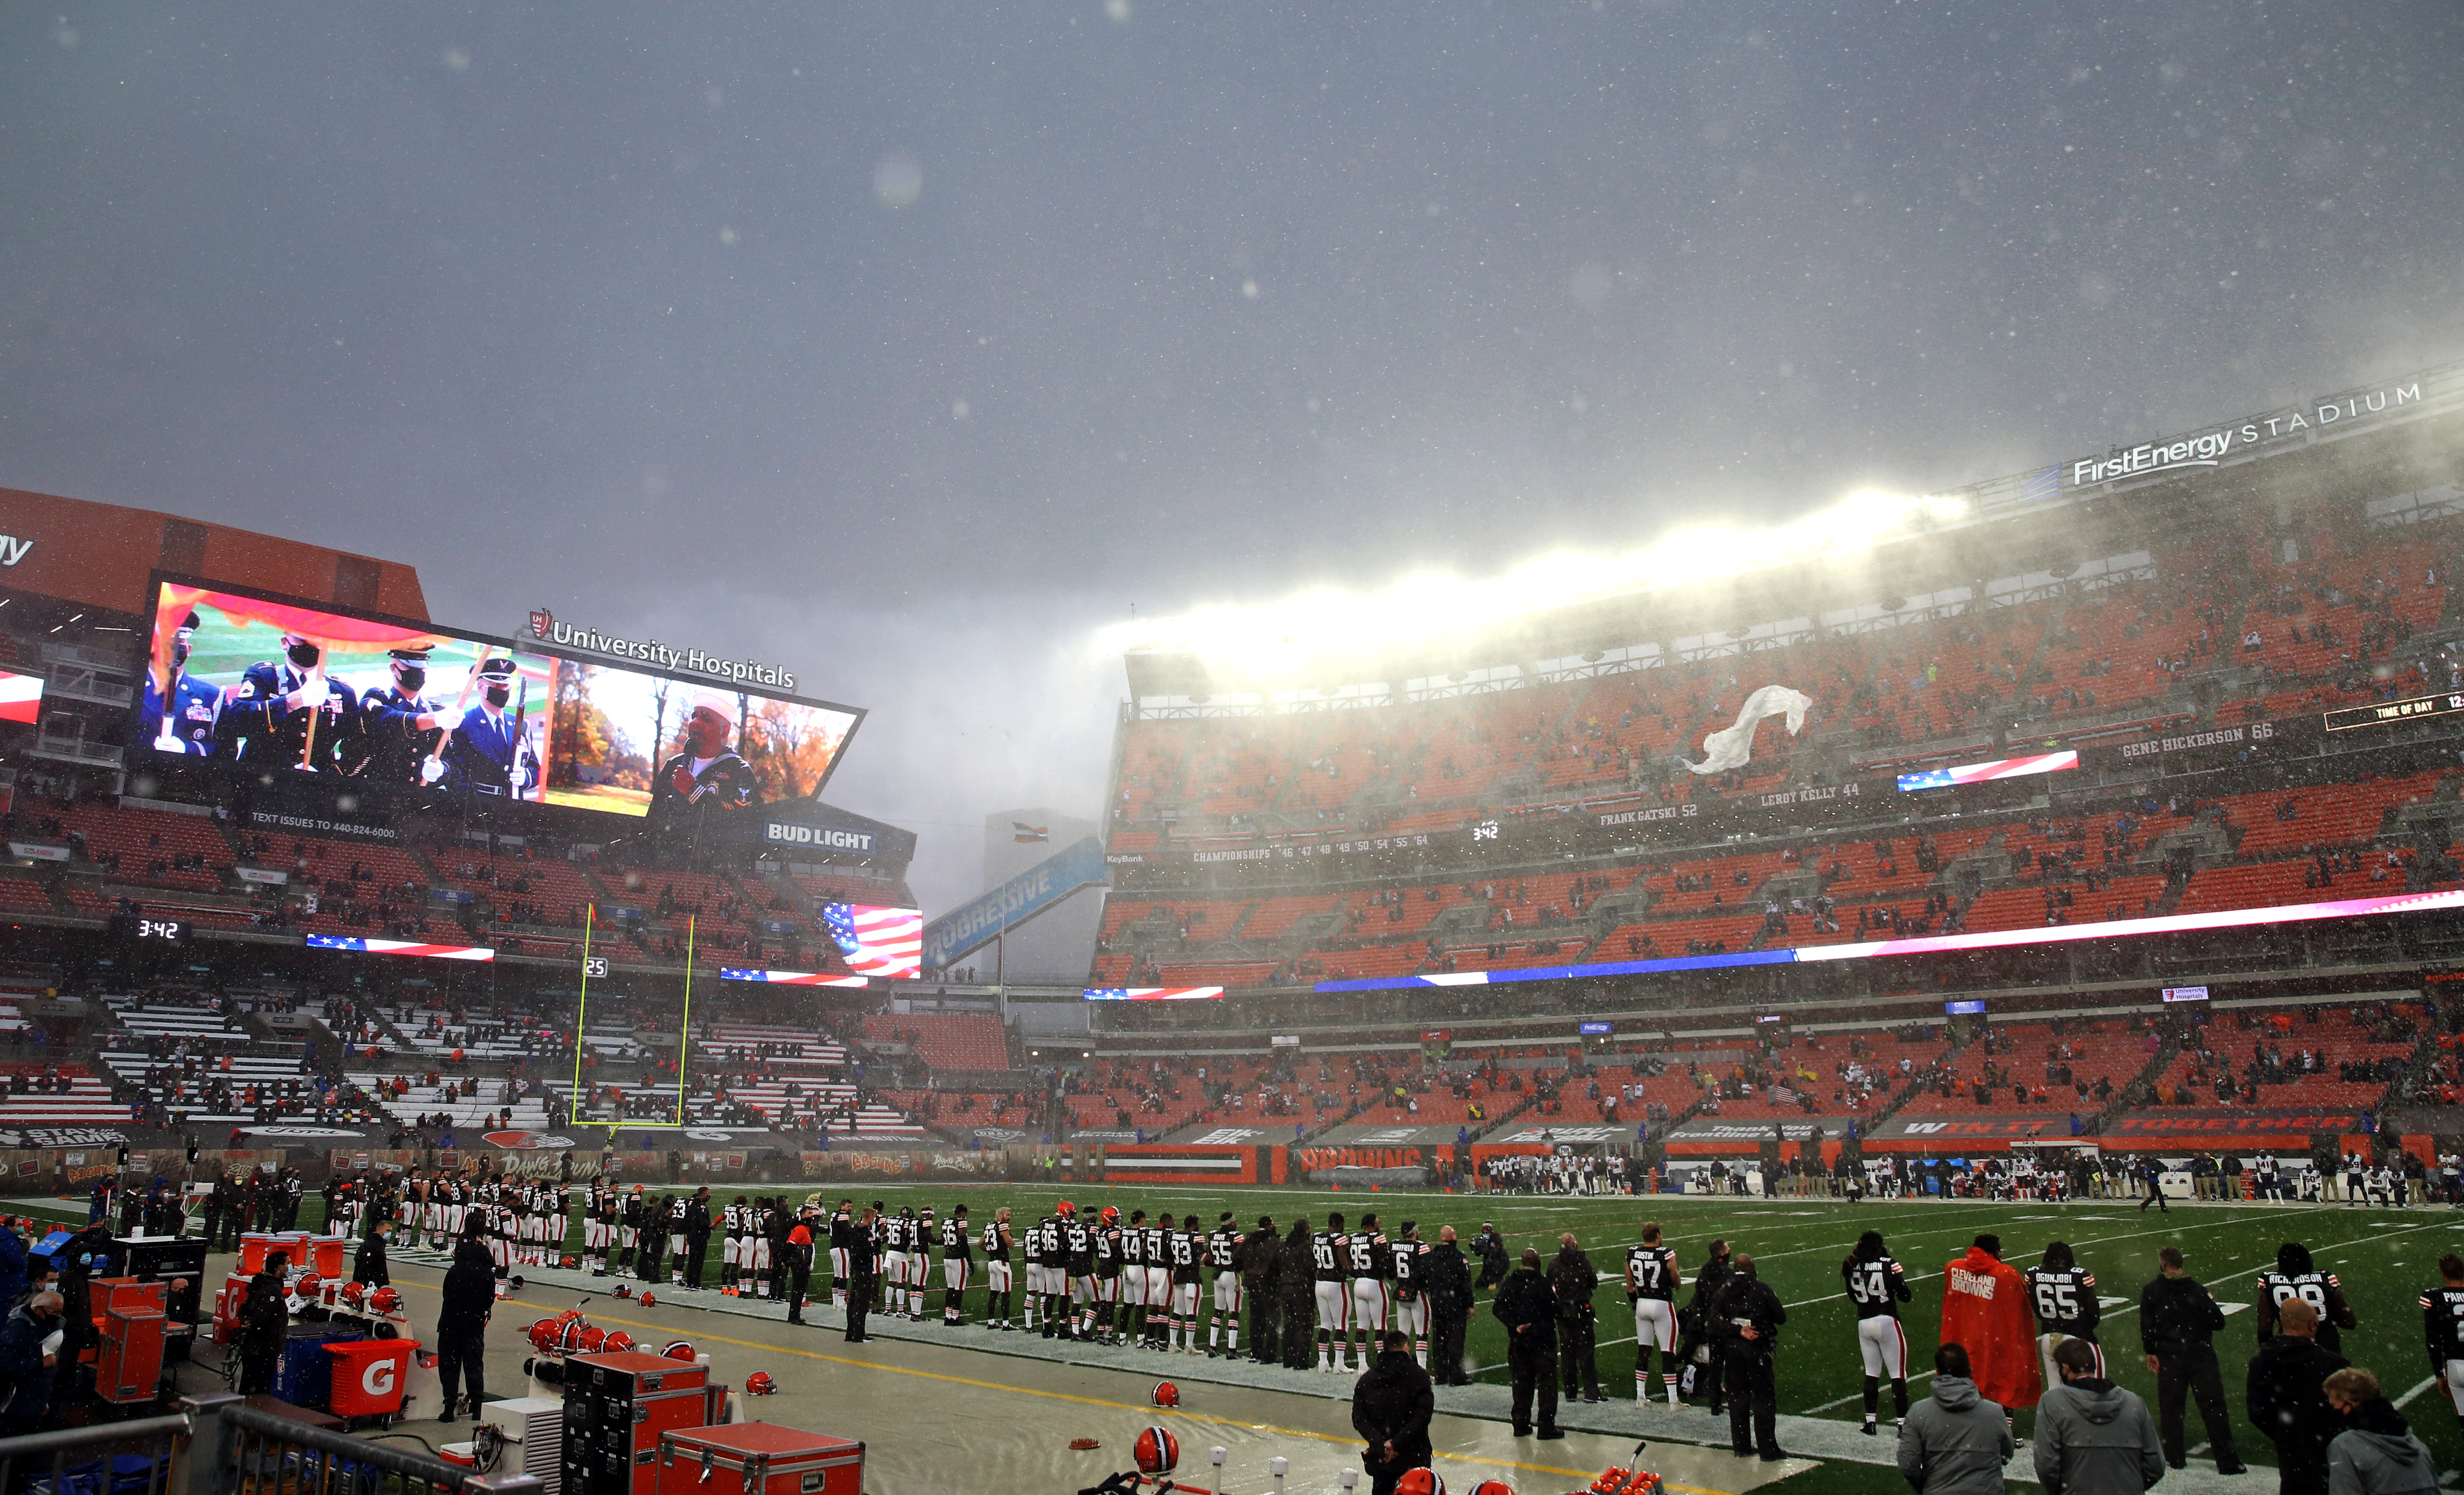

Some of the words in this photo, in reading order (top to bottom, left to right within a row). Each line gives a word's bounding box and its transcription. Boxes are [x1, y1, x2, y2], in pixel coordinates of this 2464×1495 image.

[2074, 429, 2233, 485] FirstEnergy
[2241, 383, 2421, 443] STADIUM
[552, 620, 682, 671] University
[687, 647, 794, 688] Hospitals
[2376, 705, 2398, 719] TIME
[2400, 704, 2412, 715] OF
[2414, 701, 2433, 712] DAY
[2122, 742, 2159, 757] GENE
[2162, 729, 2243, 752] HICKERSON
[2251, 723, 2274, 739] 66
[1761, 792, 1796, 807] LEROY
[1800, 788, 1837, 802] KELLY
[1843, 783, 1859, 798] 44
[252, 812, 278, 823] TEXT
[280, 815, 314, 828] ISSUES
[317, 820, 330, 829] TO
[333, 823, 394, 838] 440-824-6000
[1600, 812, 1636, 826] FRANK
[1638, 808, 1677, 821] GATSKI
[1682, 804, 1697, 817] 52
[768, 824, 810, 843] BUD
[814, 828, 872, 850] LIGHT
[1473, 826, 1498, 841] 3:42
[1107, 855, 1144, 863] KeyBank
[1193, 849, 1270, 862] CHAMPIONSHIPS
[138, 920, 178, 939] 3:42
[586, 960, 605, 975] 25
[26, 1128, 96, 1138] STAY
[265, 1127, 338, 1135] Ford
[1904, 1122, 1995, 1134] WIN
[2003, 1120, 2054, 1133] IT
[2122, 1116, 2356, 1130] TOGETHER
[1025, 1235, 1041, 1257] 42
[1068, 1229, 1087, 1251] 52
[1121, 1236, 1141, 1261] 44
[1147, 1237, 1161, 1261] 51
[1351, 1236, 1369, 1244] GARRETT
[1391, 1243, 1414, 1252] MAYFIELD
[1171, 1240, 1192, 1264] 93
[1210, 1240, 1232, 1265] 55
[1313, 1244, 1335, 1269] 90
[1350, 1244, 1372, 1269] 95
[1634, 1250, 1655, 1260] GUSTIN
[1396, 1251, 1409, 1278] 6
[1629, 1259, 1661, 1289] 97
[1850, 1271, 1889, 1303] 94
[1951, 1267, 1996, 1288] CLEVELAND
[1951, 1277, 1994, 1300] BROWNS
[2035, 1273, 2072, 1284] OGUNJOBI
[228, 1287, 240, 1320] G
[2035, 1284, 2079, 1319] 65
[362, 1359, 396, 1395] G
